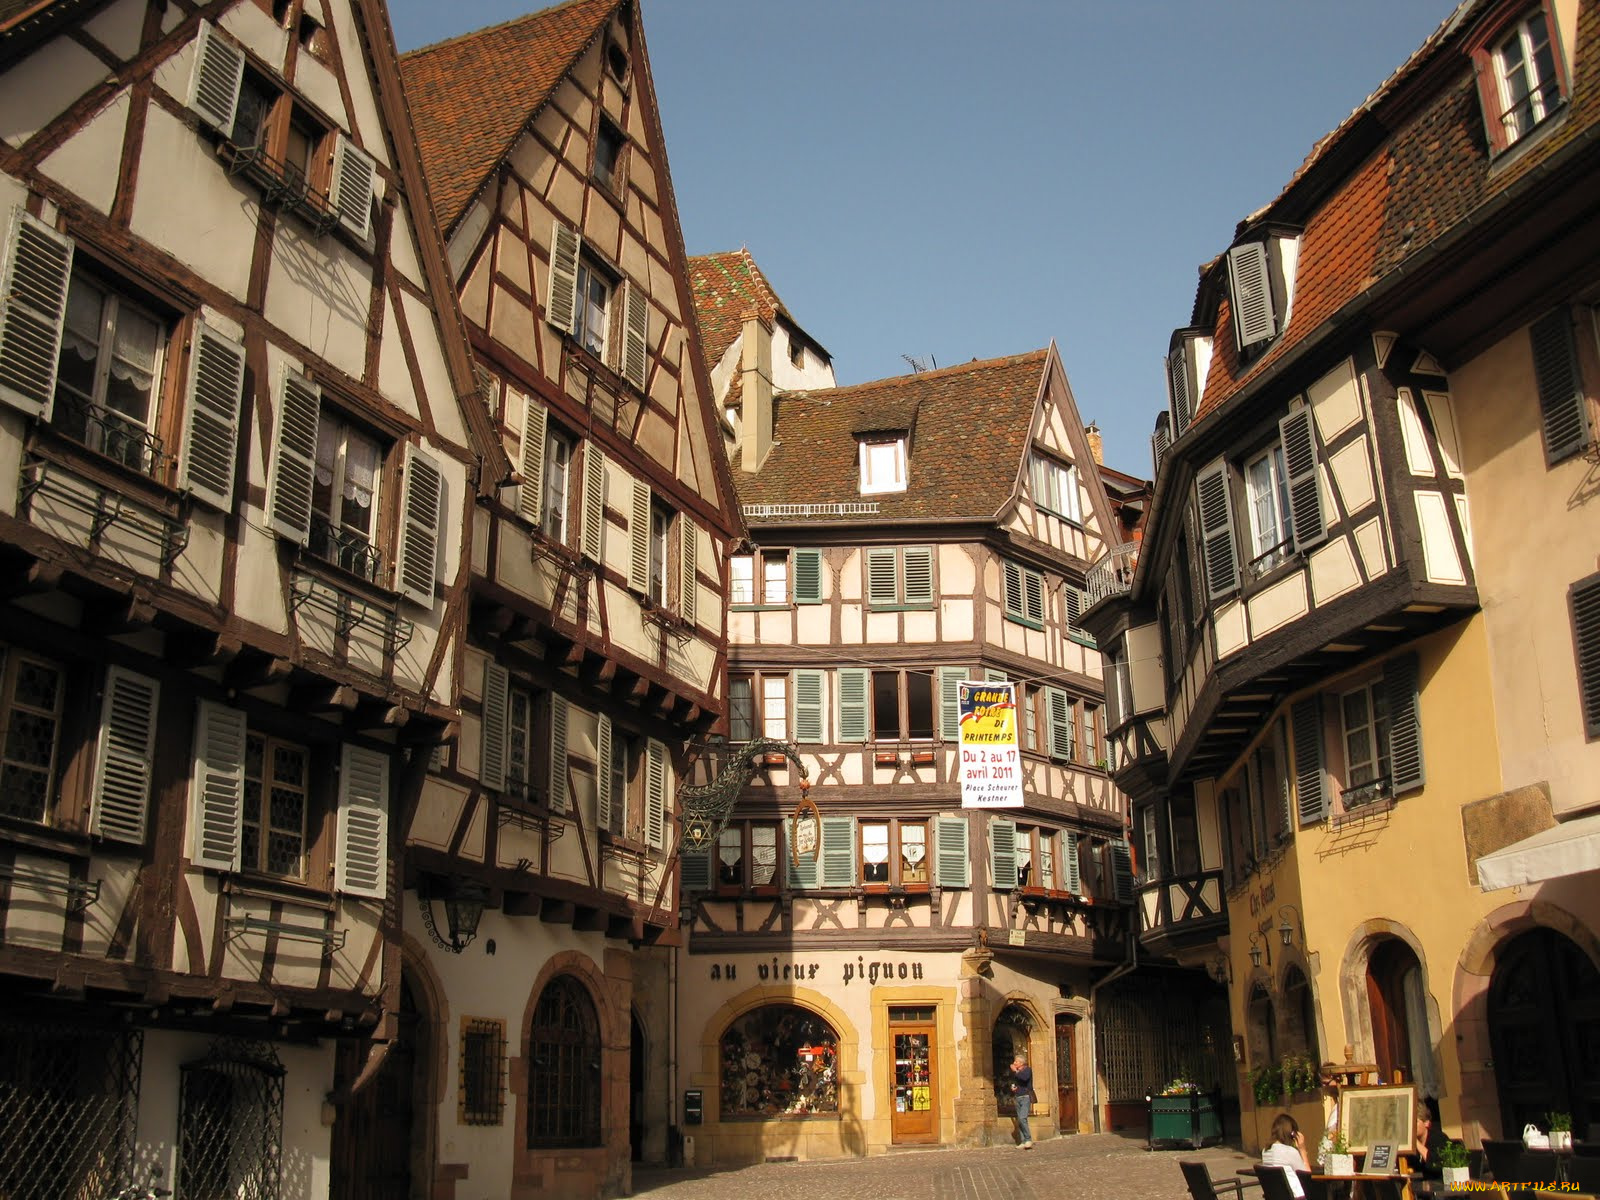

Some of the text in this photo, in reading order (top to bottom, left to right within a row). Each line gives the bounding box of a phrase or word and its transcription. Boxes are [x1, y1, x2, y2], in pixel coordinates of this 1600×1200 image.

[974, 691, 1009, 702] GRANDE
[974, 706, 1001, 717] FOIRE
[964, 733, 1013, 741] PRINTEMPS
[963, 750, 1016, 762] Du 2 au 17
[966, 766, 1013, 779] avril 2011
[710, 955, 923, 985] au vieux pignon
